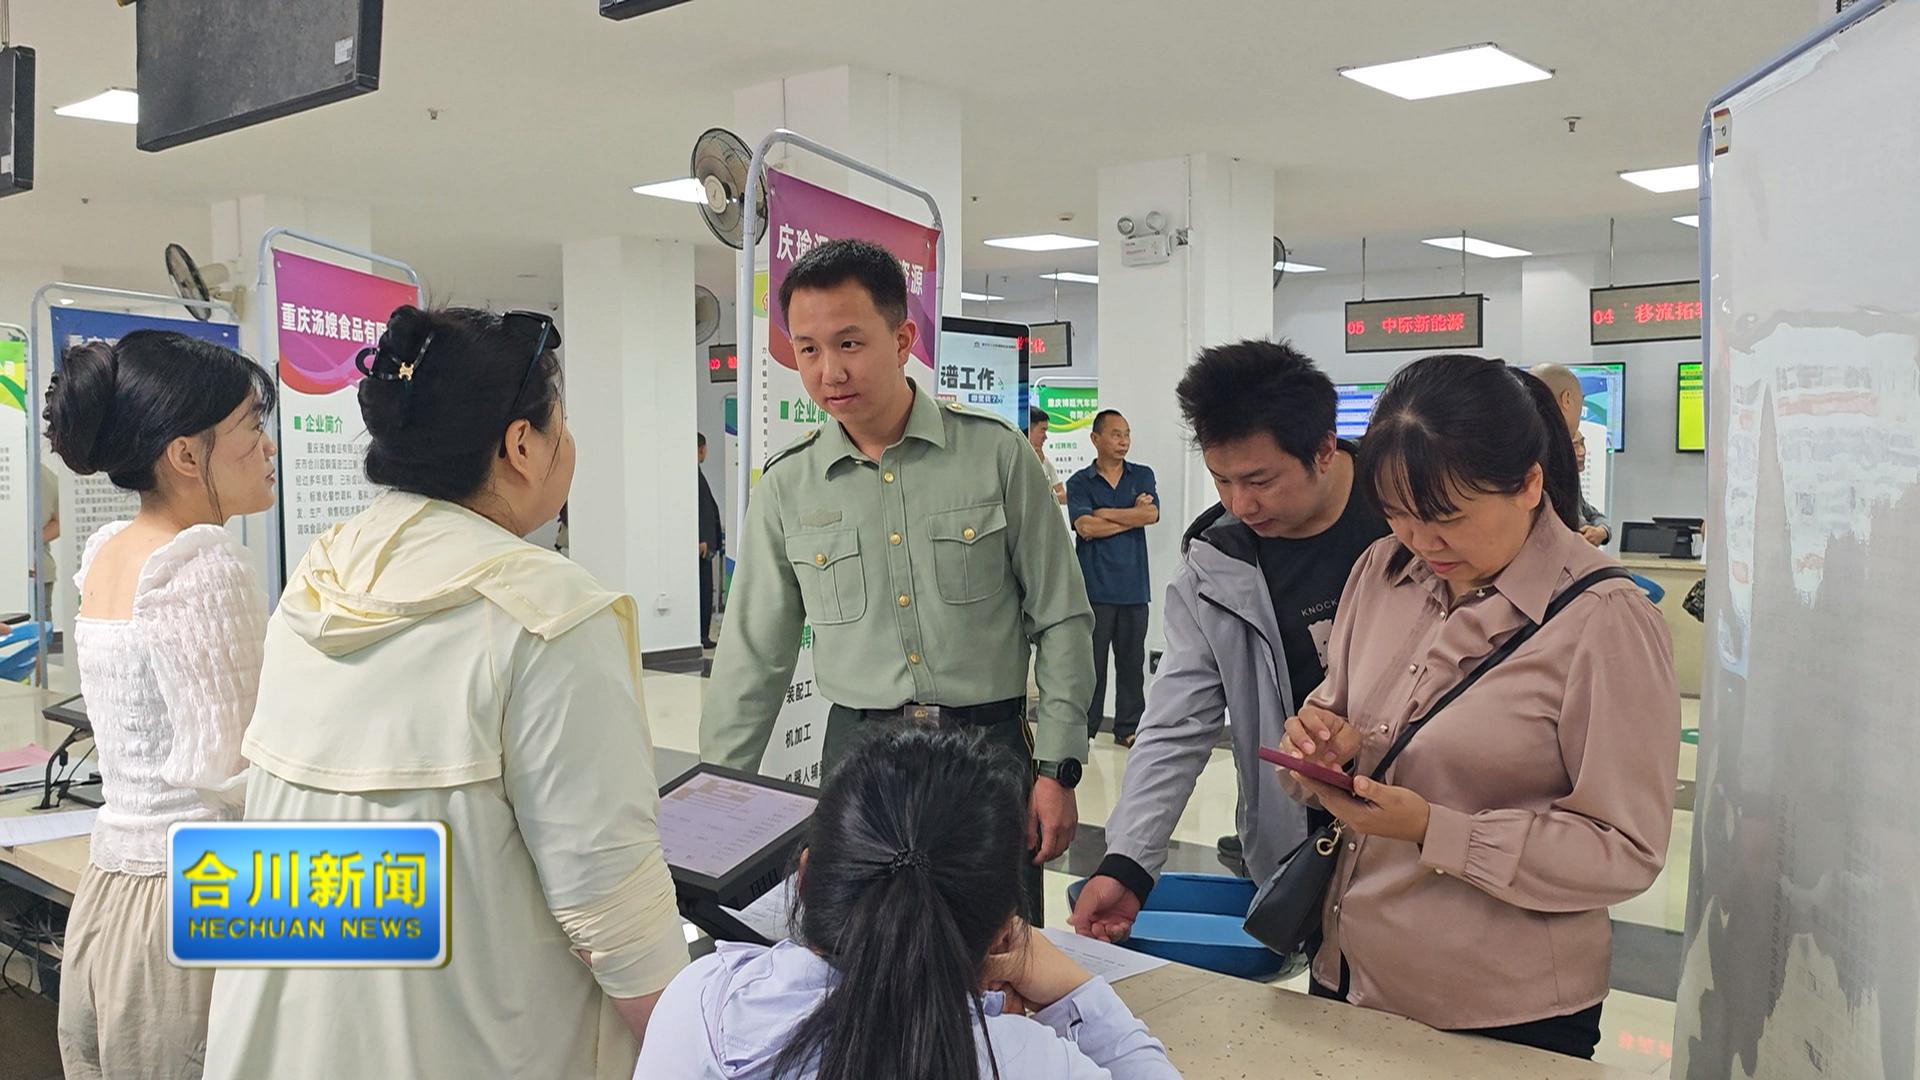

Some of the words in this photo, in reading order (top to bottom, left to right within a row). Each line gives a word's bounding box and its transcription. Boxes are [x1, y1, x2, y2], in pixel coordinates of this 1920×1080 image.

[1347, 319, 1365, 335] 05
[1382, 311, 1464, 334] 中际新能源
[1593, 308, 1614, 325] 04
[305, 414, 343, 434] 企业简介
[785, 723, 811, 748] 机加工
